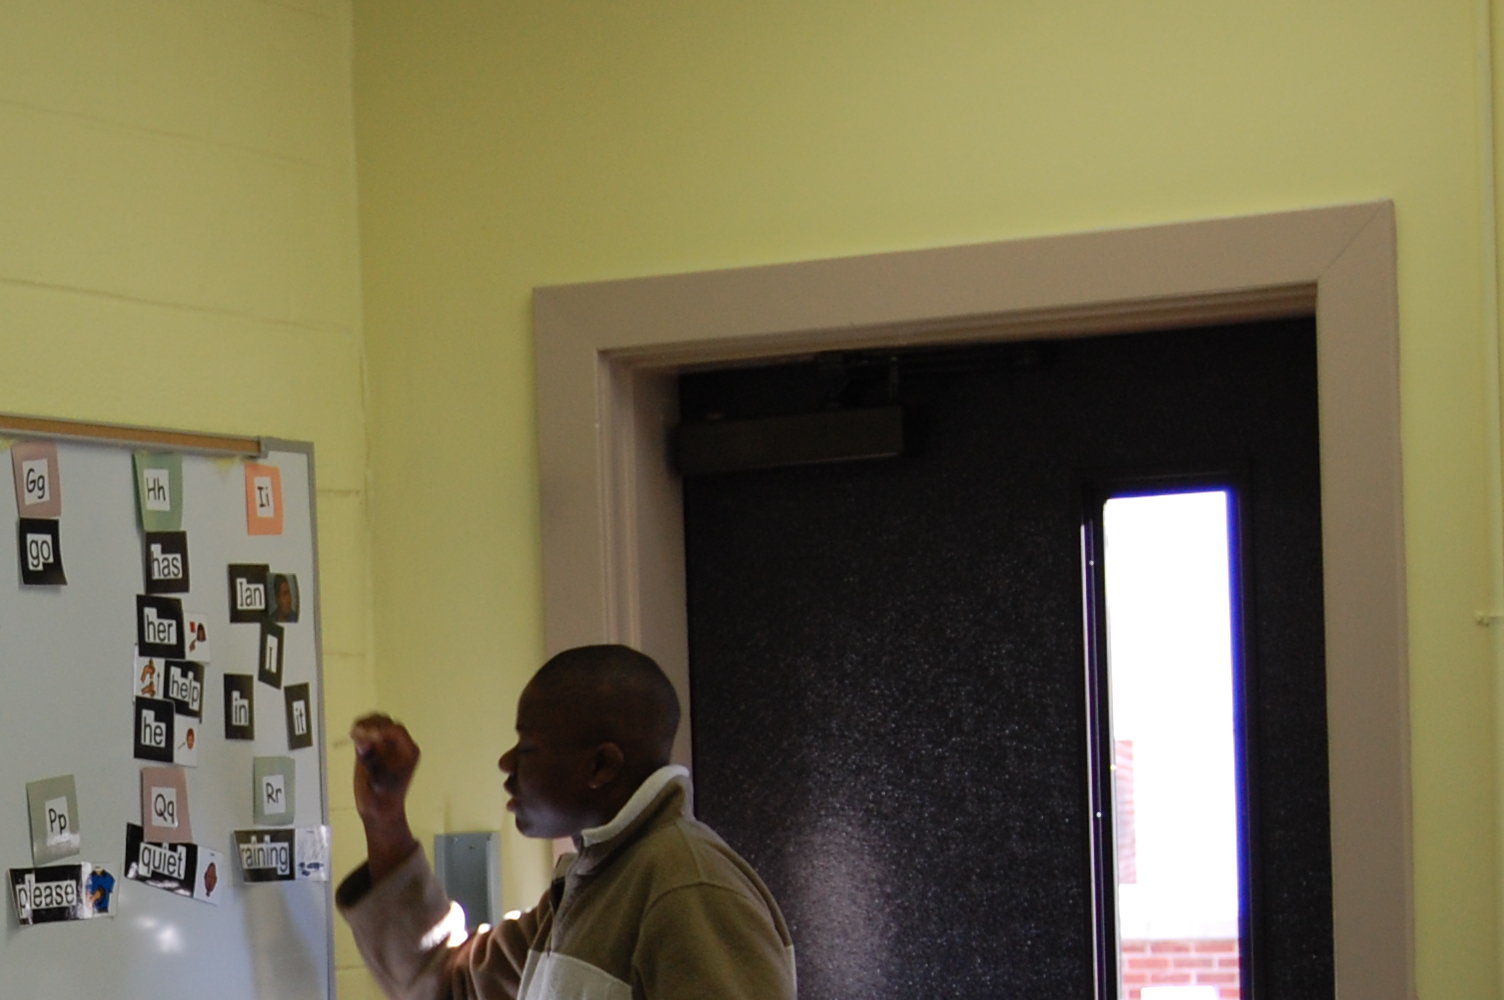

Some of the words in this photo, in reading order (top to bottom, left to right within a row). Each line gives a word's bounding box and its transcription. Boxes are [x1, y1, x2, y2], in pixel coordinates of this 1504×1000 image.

[25, 467, 46, 500] Gg
[146, 477, 166, 502] Hh
[257, 485, 270, 509] Ii
[29, 537, 52, 569] go
[151, 550, 181, 578] has
[239, 581, 264, 608] Ian
[146, 613, 174, 643] her
[171, 672, 200, 707] help
[233, 696, 248, 725] in
[295, 706, 306, 734] it
[143, 715, 164, 747] he
[265, 781, 283, 804] Rr
[48, 807, 68, 836] Pp
[153, 792, 176, 825] Qq
[141, 845, 185, 880] quiet
[17, 877, 77, 910] please
